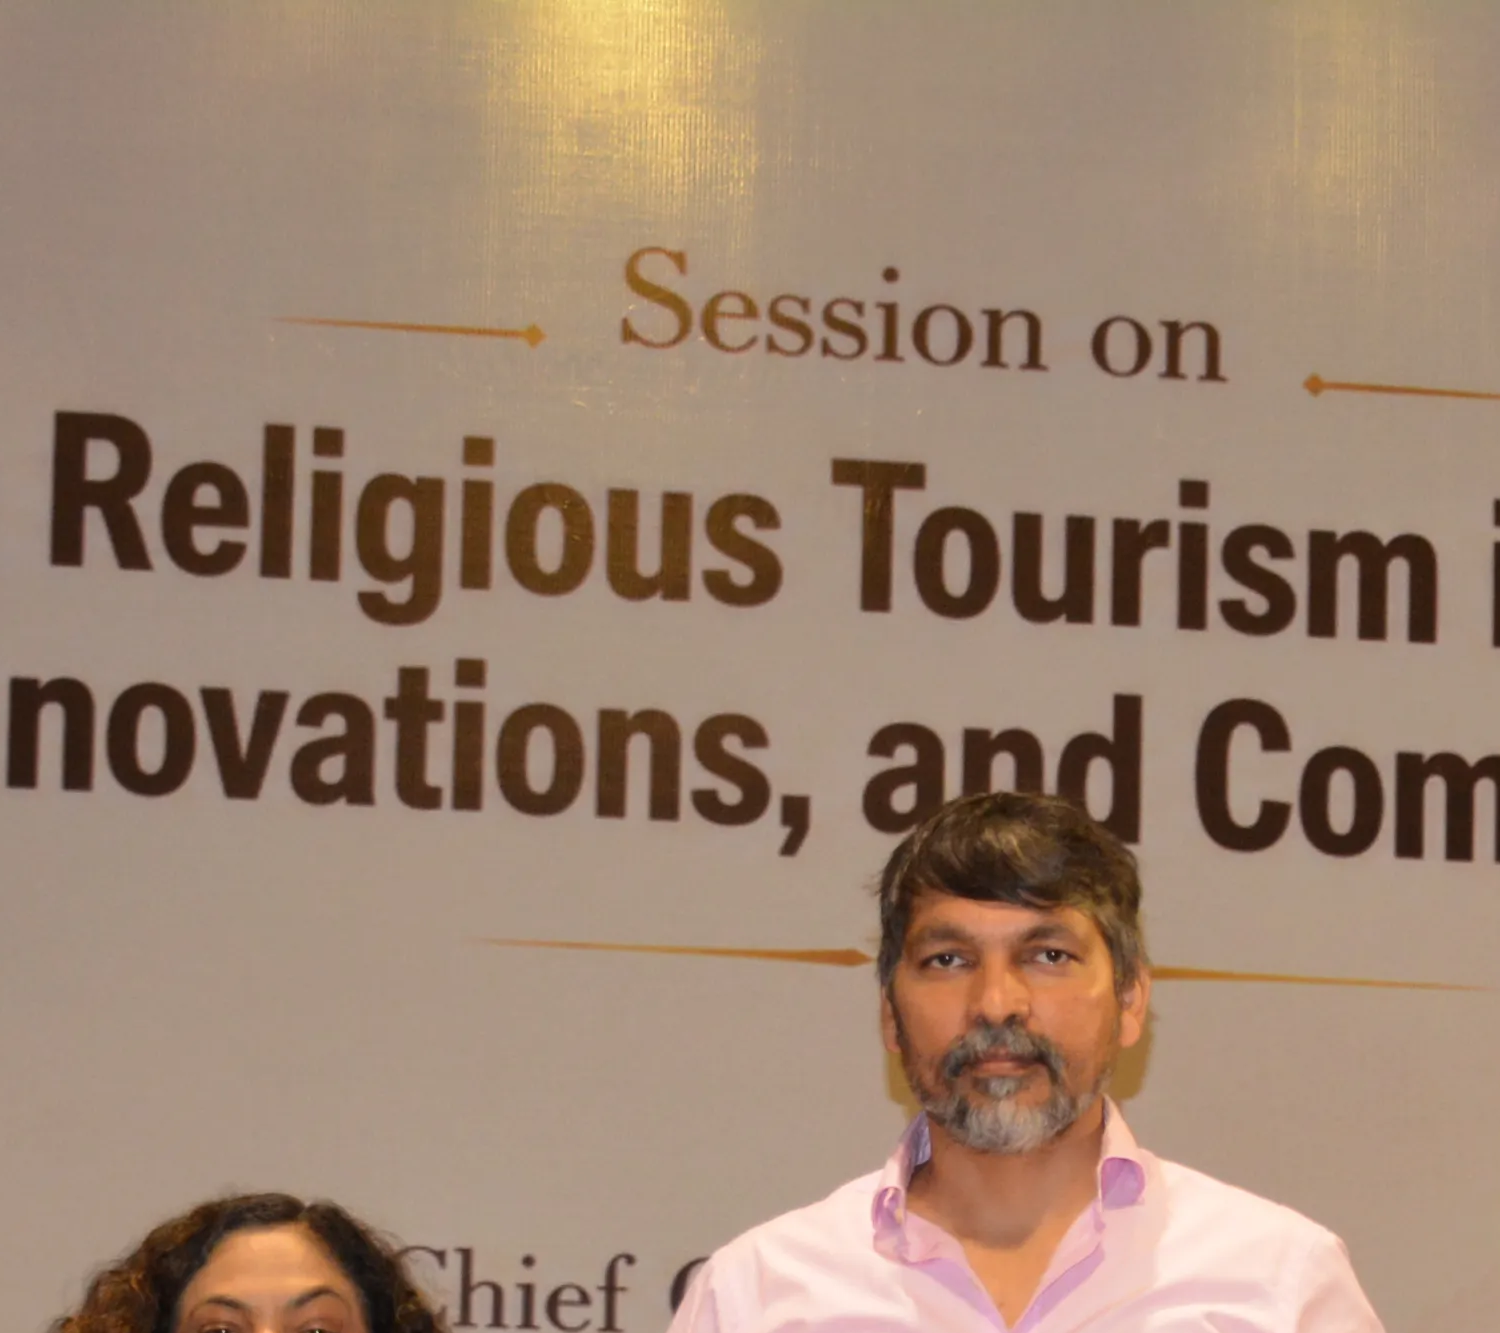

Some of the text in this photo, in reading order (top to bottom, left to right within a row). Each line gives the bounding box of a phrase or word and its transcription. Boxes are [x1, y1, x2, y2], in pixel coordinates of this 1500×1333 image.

[620, 246, 1229, 383] Session on
[51, 411, 781, 625] Religious
[832, 459, 1438, 643] Tourism
[861, 694, 1143, 843] and
